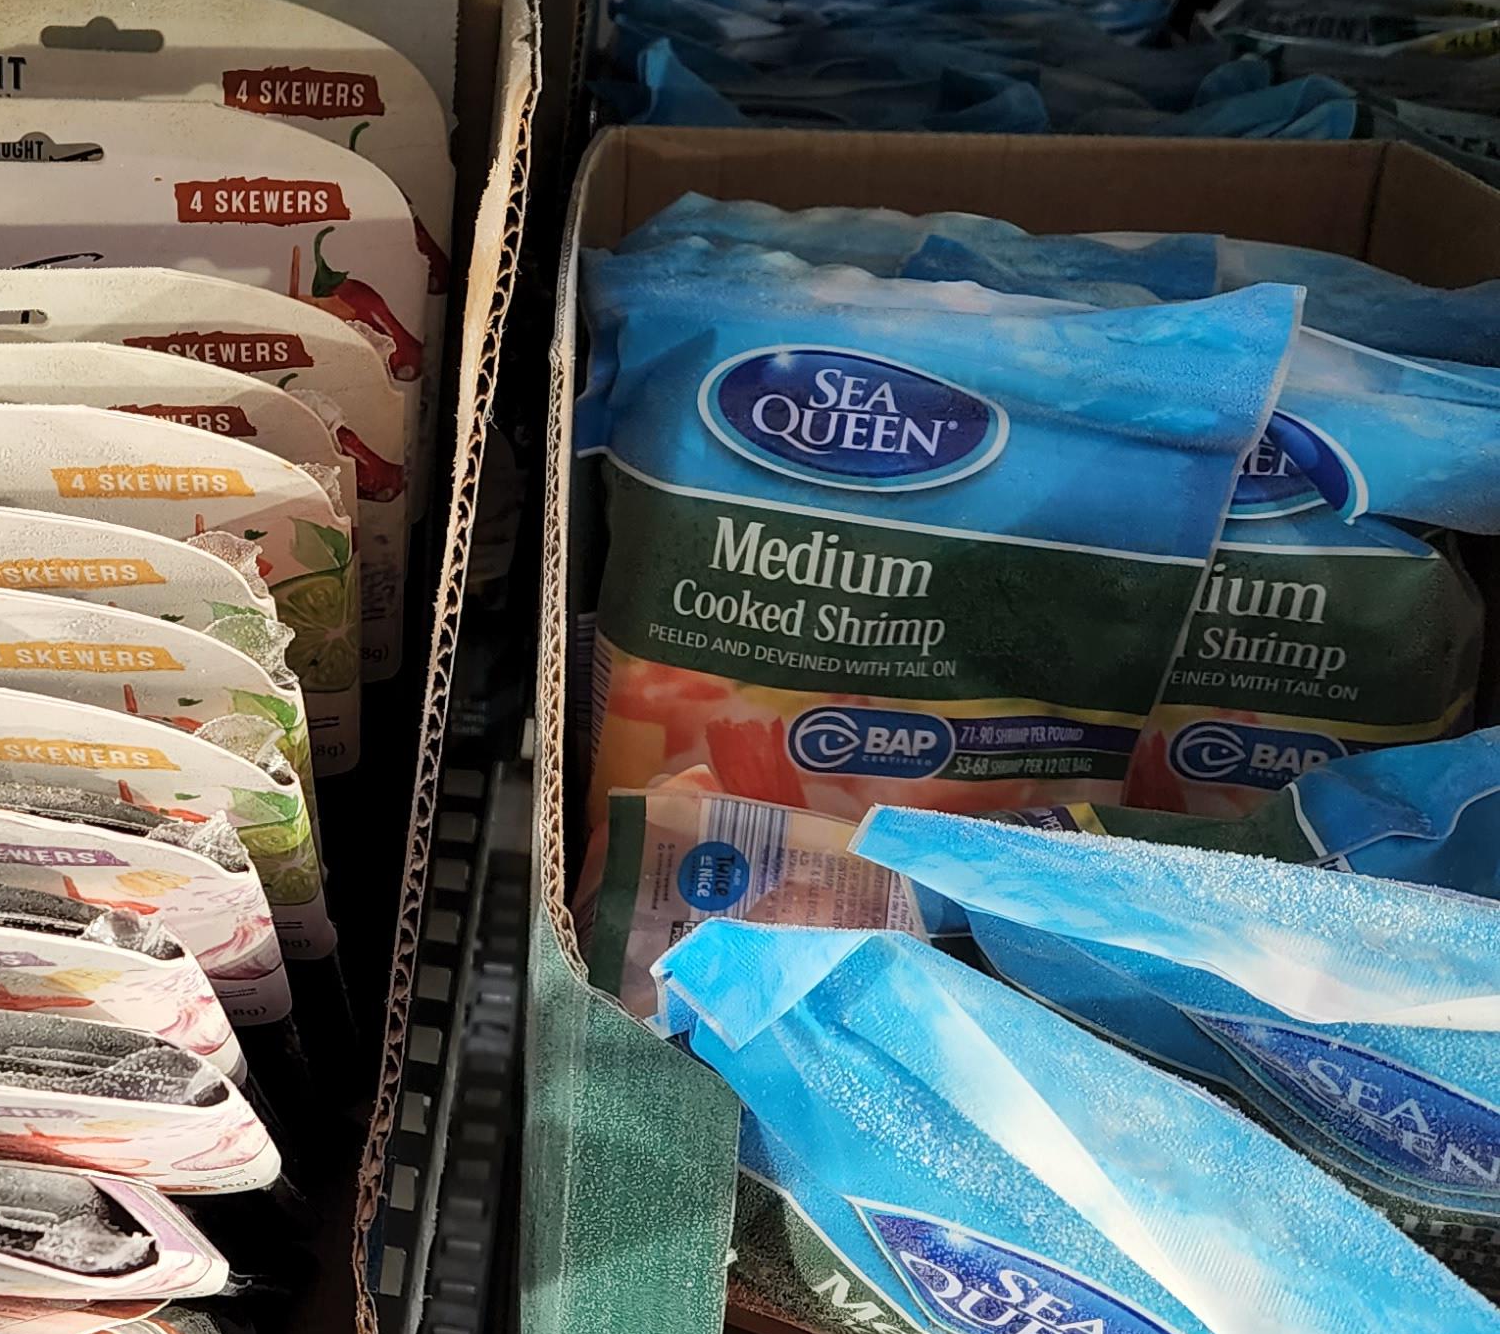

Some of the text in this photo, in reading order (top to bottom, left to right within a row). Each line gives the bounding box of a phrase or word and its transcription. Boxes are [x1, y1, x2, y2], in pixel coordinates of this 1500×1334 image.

[235, 79, 366, 107] 4 SKEWERS
[189, 189, 329, 214] 4 SKEWERS
[808, 366, 900, 415] SEA
[751, 394, 945, 459] QUEEN
[71, 473, 230, 493] 4 SKEWERS
[708, 516, 933, 598] Medium
[0, 565, 139, 585] SKEWERS
[672, 578, 946, 656] Cooked Shrimp
[18, 647, 156, 668] SKEWERS
[648, 622, 957, 678] PEELED AND DEVEINED WITH TAIL ON
[1198, 625, 1347, 680] Shrimp
[1230, 674, 1360, 702] WITH TAIL ON
[864, 727, 940, 758] BAP
[959, 725, 1085, 743] 71-90 POUND
[3, 743, 151, 767] SKEWERS
[1300, 1057, 1432, 1135] SEA
